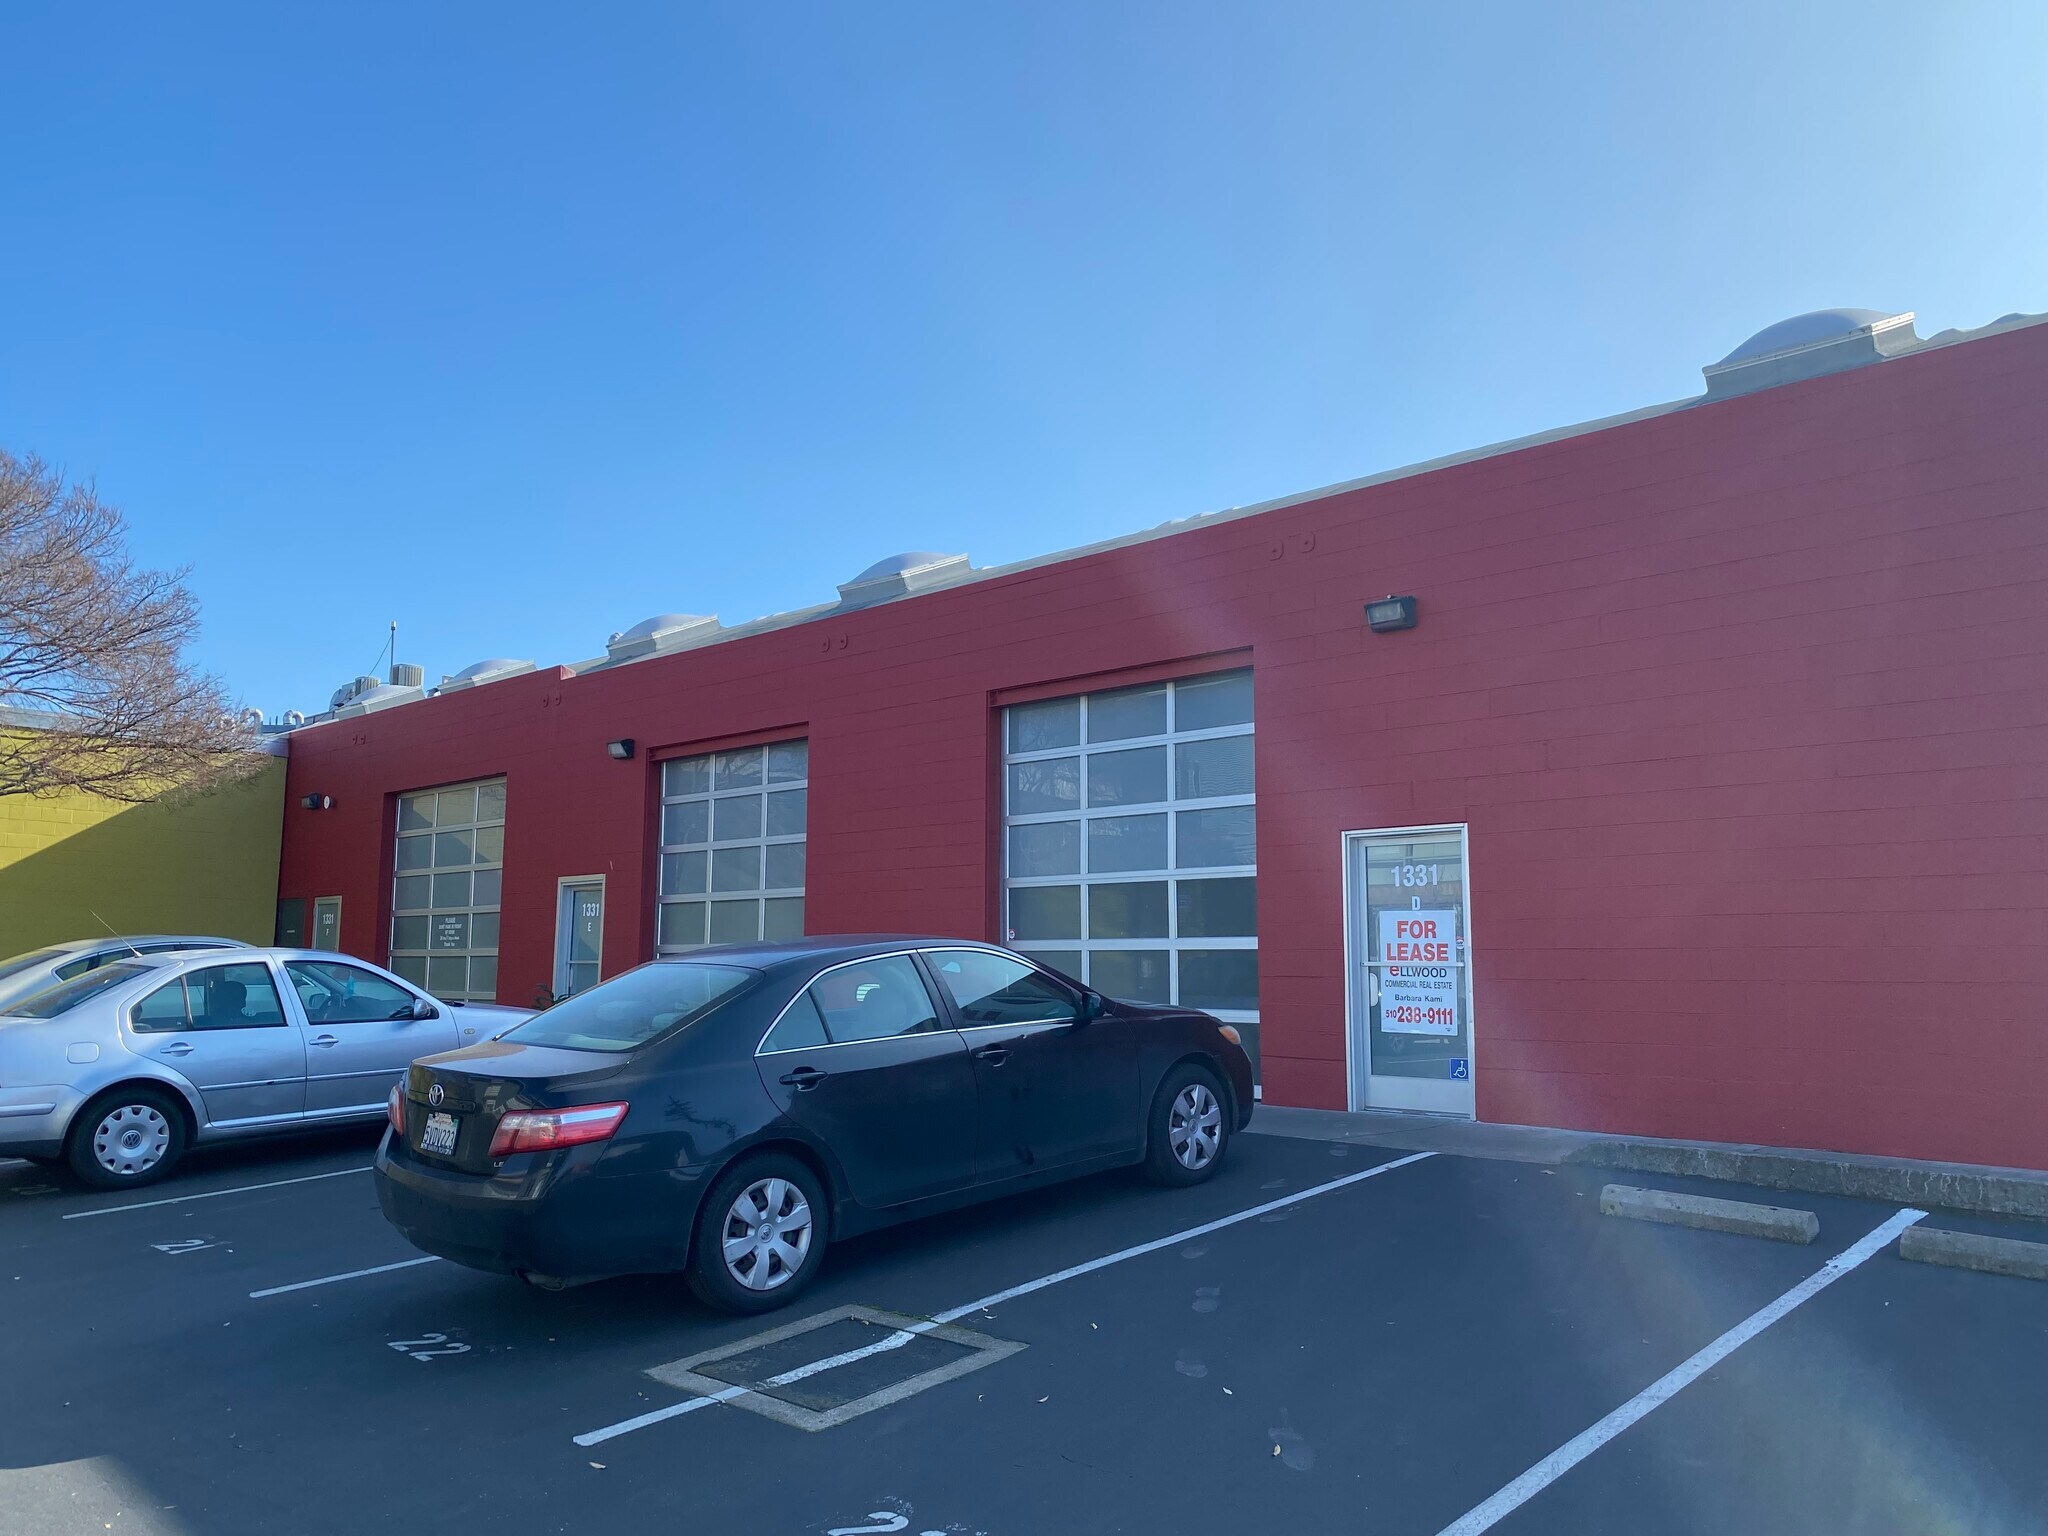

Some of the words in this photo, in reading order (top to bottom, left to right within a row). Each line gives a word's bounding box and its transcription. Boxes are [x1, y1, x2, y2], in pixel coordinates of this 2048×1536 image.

[1390, 864, 1438, 887] 1331
[582, 903, 600, 917] 1331
[1411, 895, 1421, 911] D
[322, 913, 334, 925] 1331
[588, 922, 592, 932] E
[1396, 920, 1437, 939] FOR
[1386, 943, 1449, 962] LEASE
[1384, 979, 1418, 989] COMMERCIAL
[1419, 981, 1432, 989] REAL
[1433, 981, 1453, 990] ESTATE
[1394, 993, 1422, 1002] Barbara
[1424, 995, 1443, 1003] Kami
[387, 1332, 472, 1362] 22
